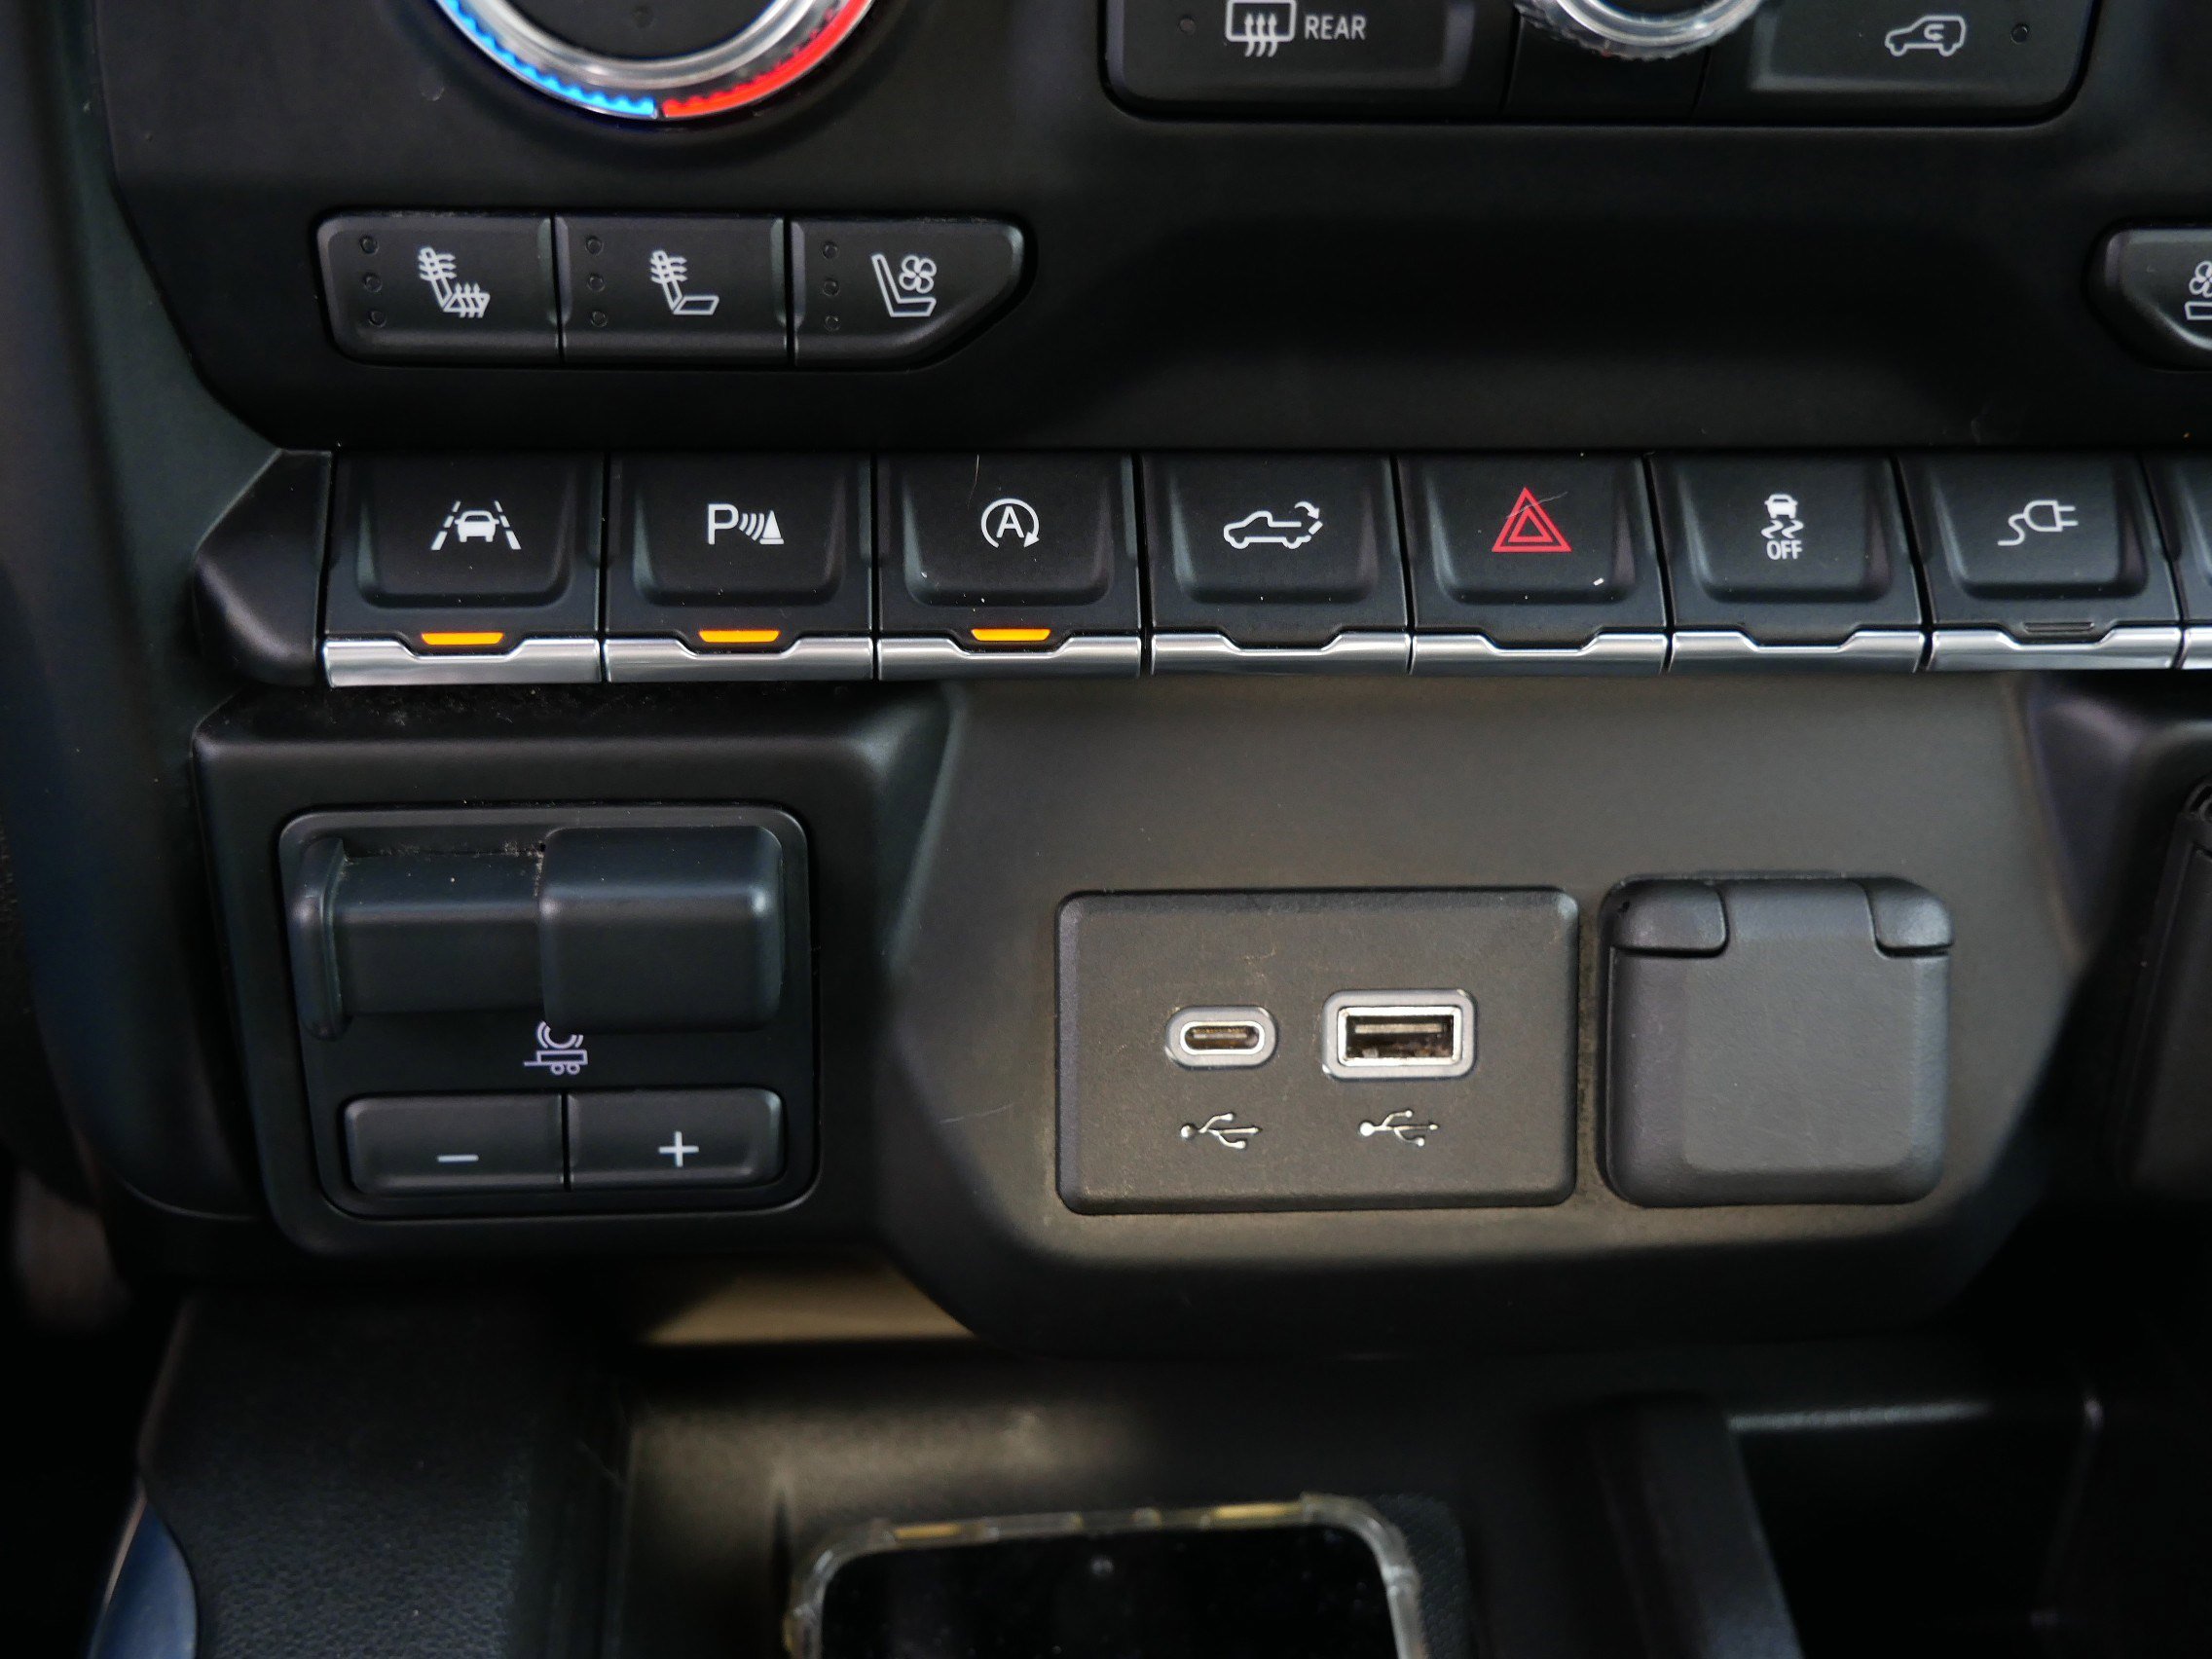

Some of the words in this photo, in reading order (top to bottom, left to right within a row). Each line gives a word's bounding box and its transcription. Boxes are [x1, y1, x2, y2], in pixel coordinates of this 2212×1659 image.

[1305, 15, 1367, 40] REAR
[708, 503, 739, 545] P
[996, 505, 1025, 538] A
[1766, 539, 1803, 561] OFF
